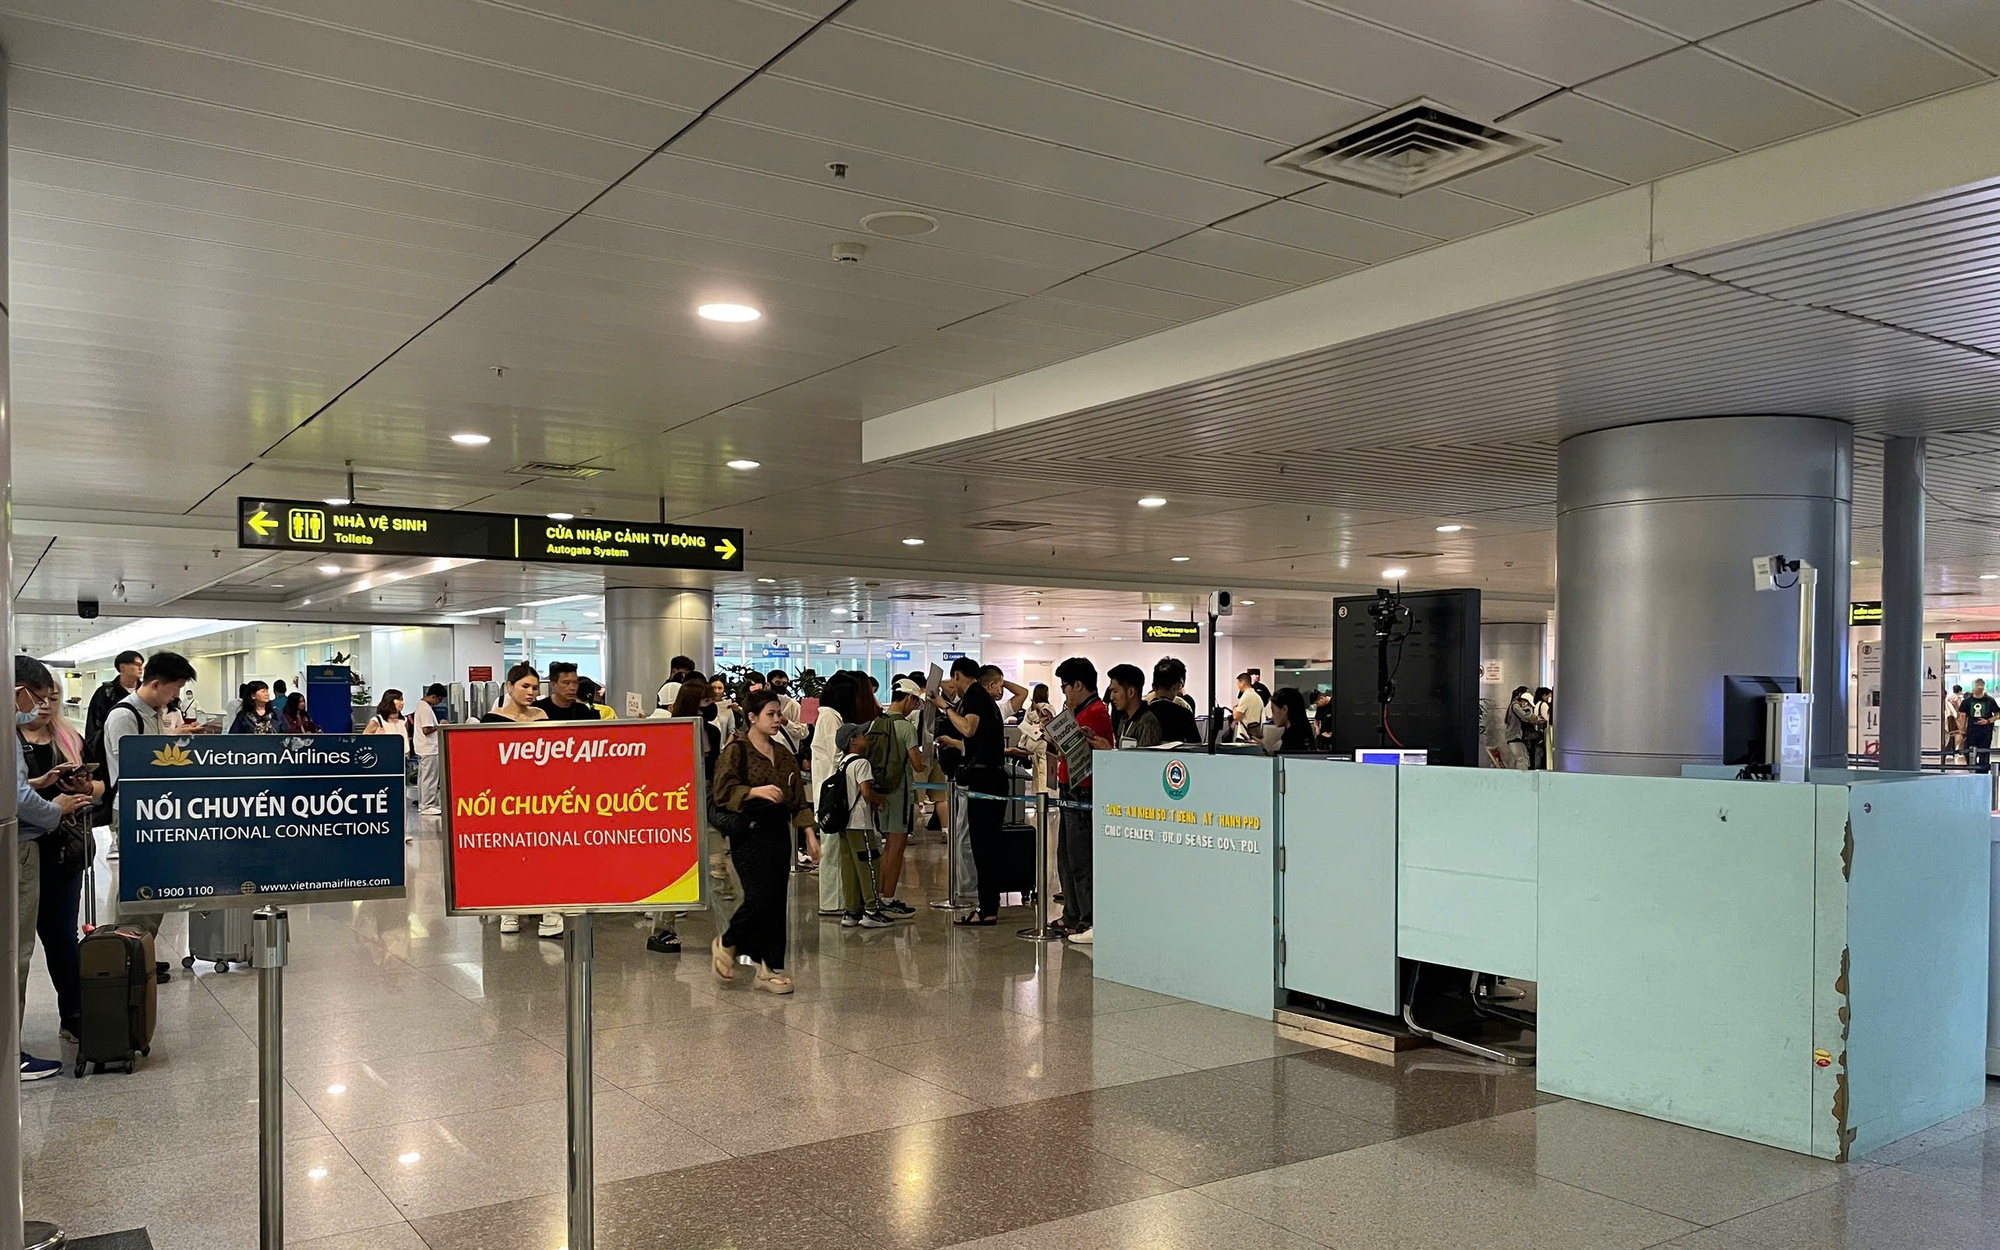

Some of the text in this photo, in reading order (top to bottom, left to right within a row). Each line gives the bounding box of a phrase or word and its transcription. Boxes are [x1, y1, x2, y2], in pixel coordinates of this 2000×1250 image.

[333, 513, 427, 532] NHÀ VỆ SINH
[334, 532, 373, 545] Toilets
[546, 524, 706, 549] CỬA NHẬP CẢNH TỰ ĐỘNG
[546, 543, 629, 559] Autogate System
[560, 633, 567, 642] 7
[835, 640, 841, 648] 3
[193, 748, 350, 766] Vietnam Airlines
[136, 786, 389, 821] NỐI CHUYẾN QUỐC TẾ
[456, 782, 691, 817] NỐI CHUYẾN QUỐC TẾ
[136, 821, 390, 843] INTERNATIONAL CONNECTIONS
[458, 827, 692, 849] INTERNATIONAL CONNECTIONS
[157, 885, 214, 898] 1900 1100
[260, 878, 391, 892] www.vietnamairlines.com
